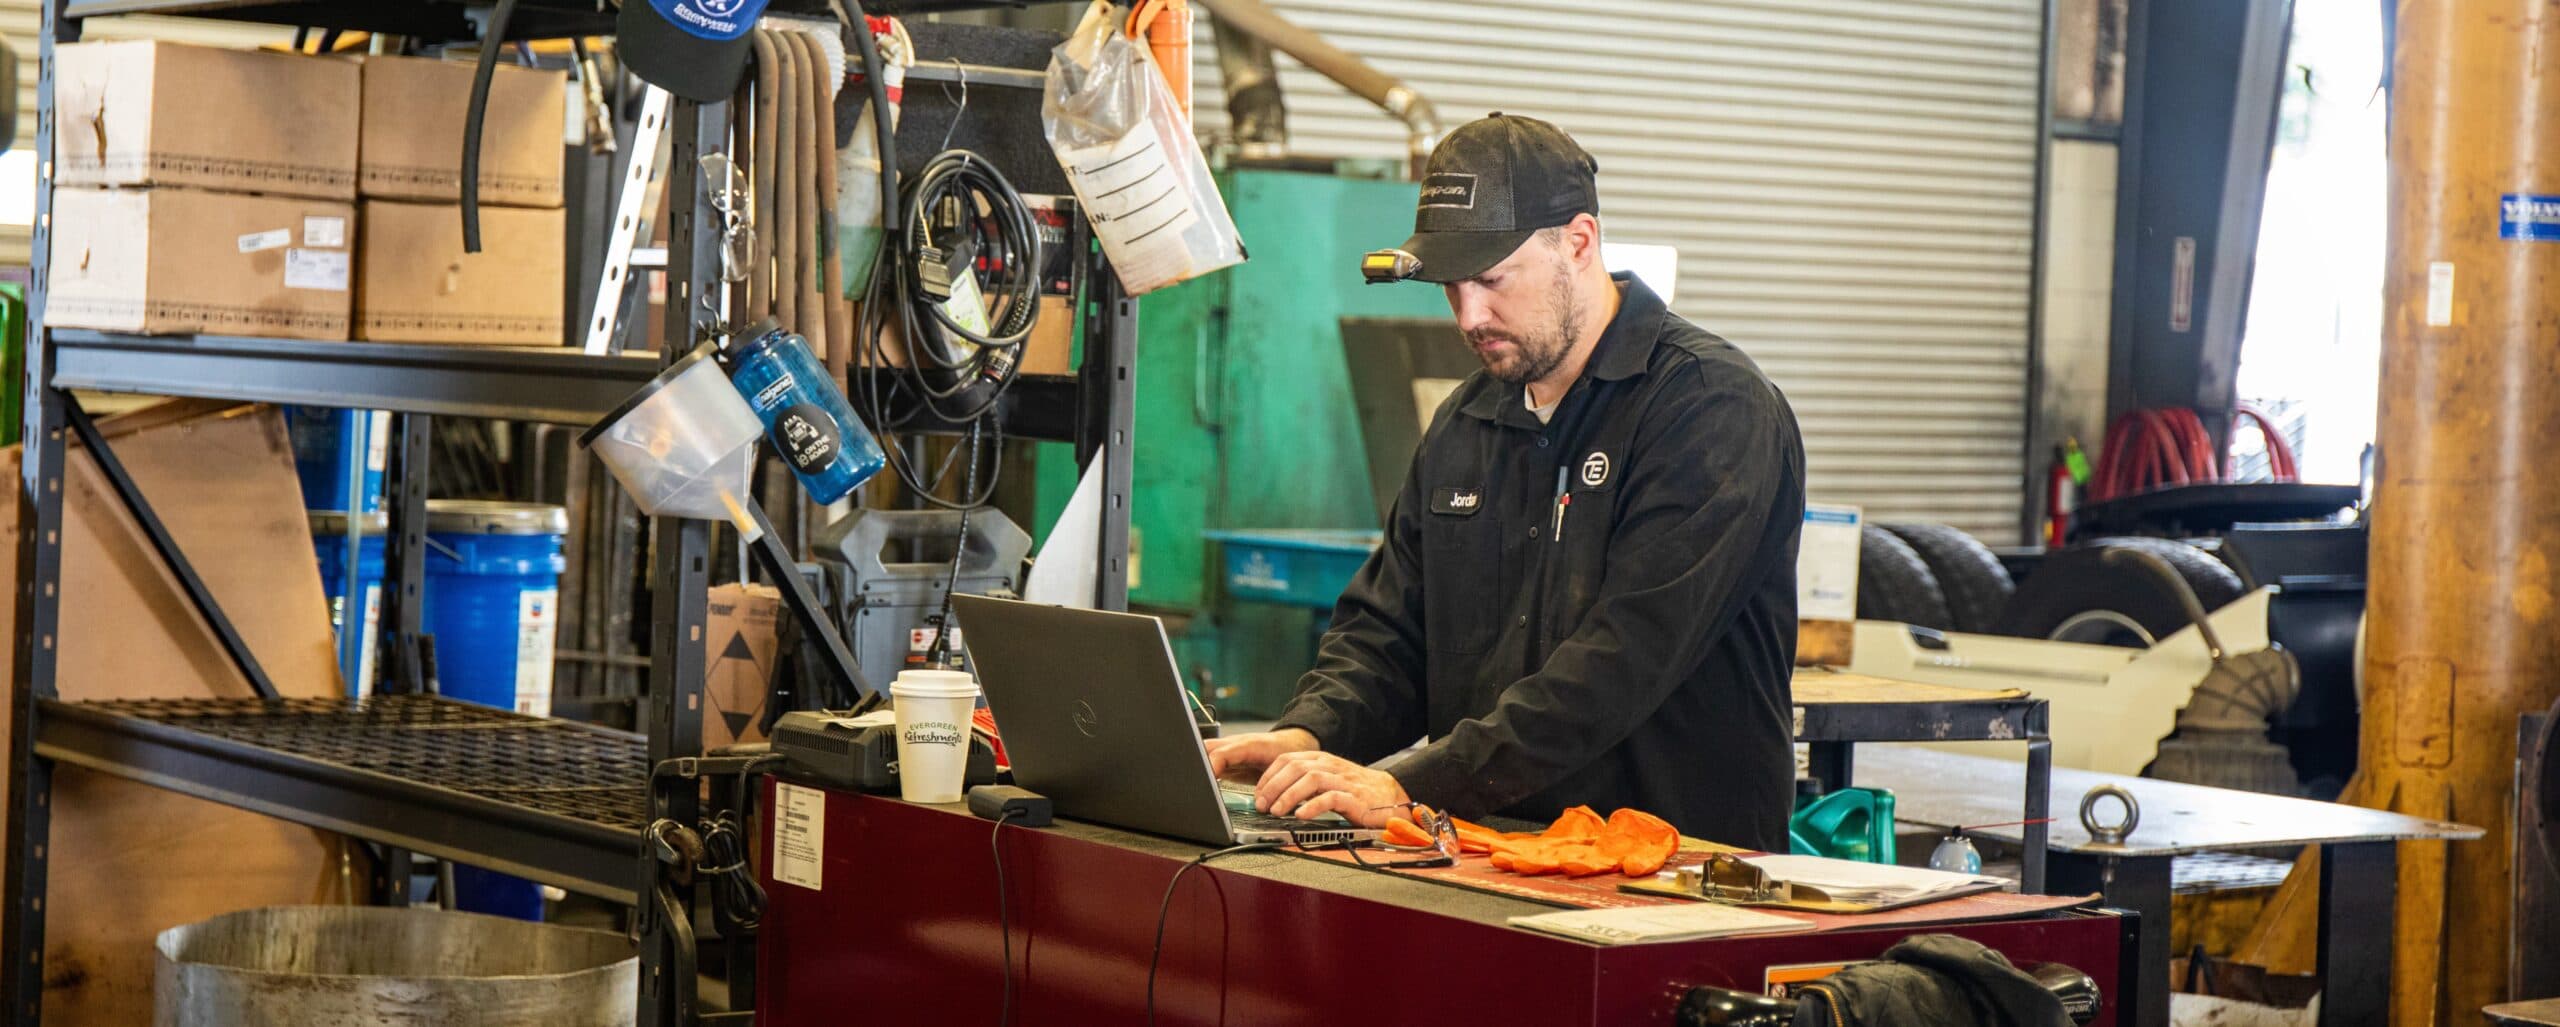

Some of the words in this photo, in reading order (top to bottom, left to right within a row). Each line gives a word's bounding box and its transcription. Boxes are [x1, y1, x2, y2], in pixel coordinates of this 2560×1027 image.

[2503, 200, 2560, 217] VOLV
[808, 443, 830, 462] ROAD
[1450, 491, 1478, 508] Jord
[909, 721, 958, 732] EVERGREEN
